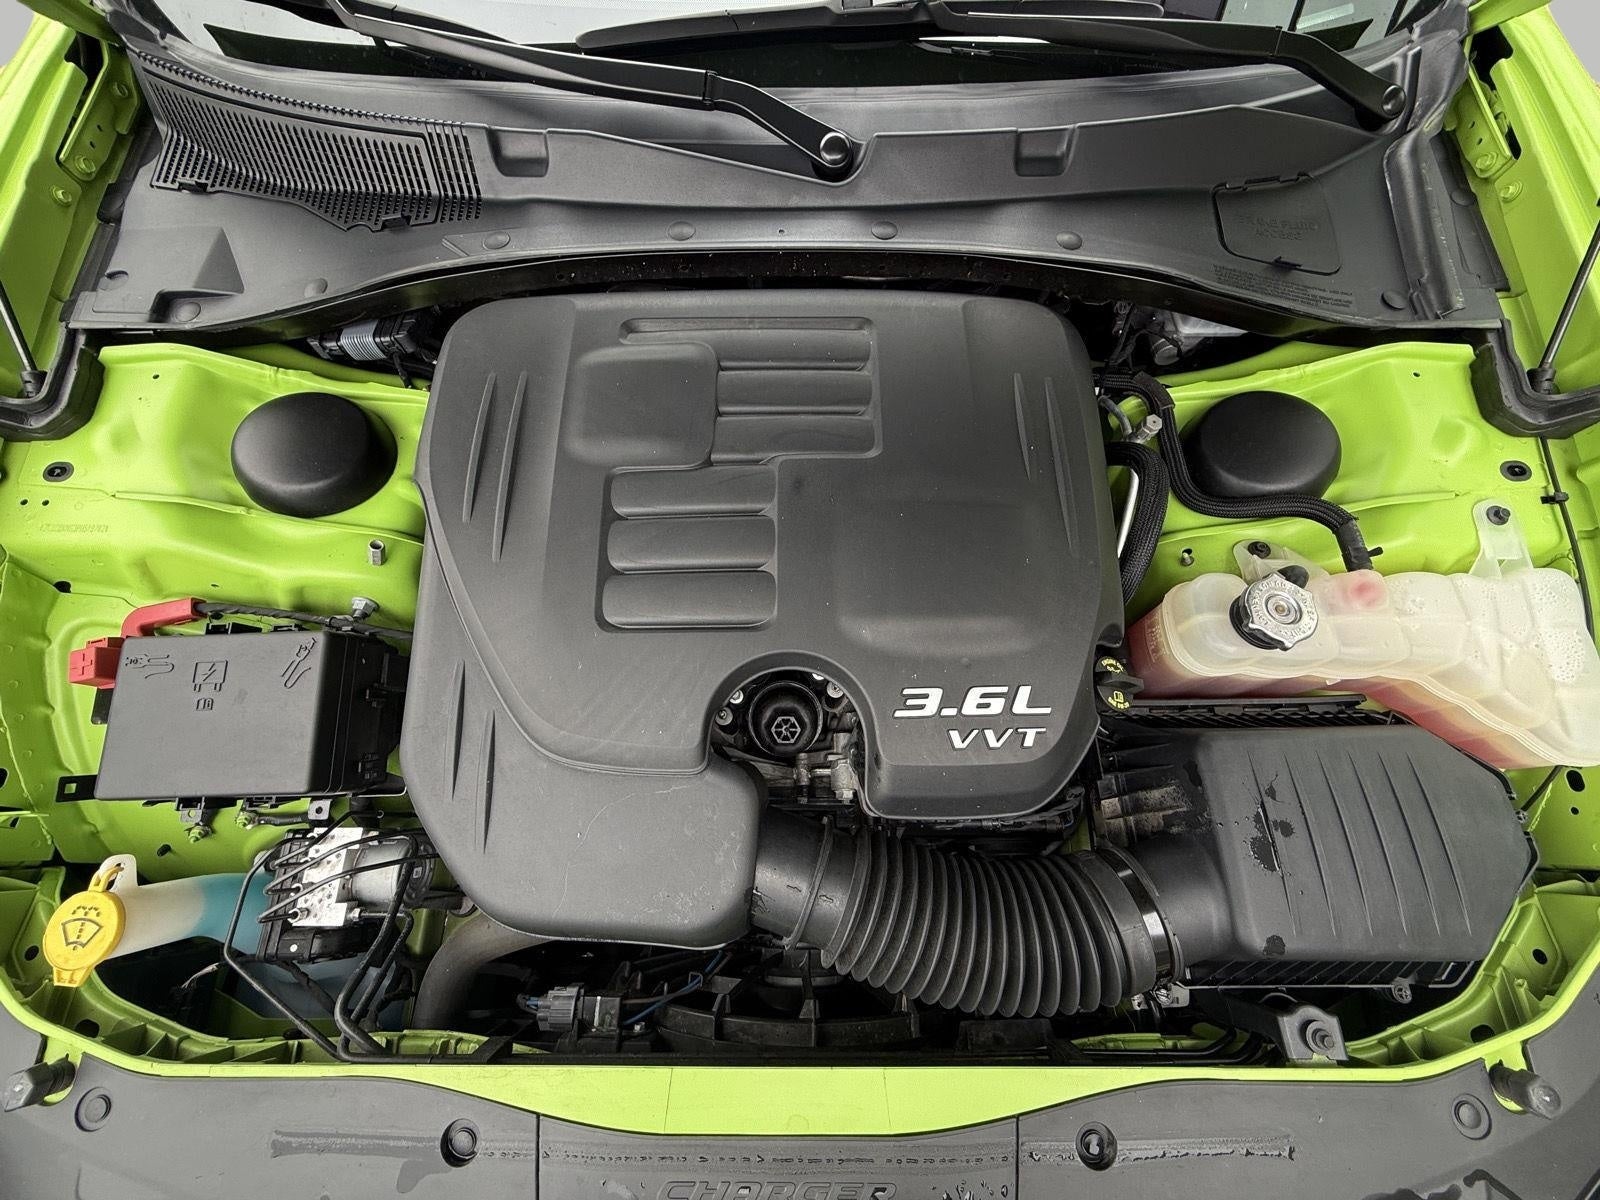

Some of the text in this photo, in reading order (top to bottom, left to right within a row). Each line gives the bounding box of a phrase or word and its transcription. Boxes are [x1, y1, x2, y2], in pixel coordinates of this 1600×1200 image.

[894, 686, 1052, 718] 3.6L
[948, 728, 1047, 749] VVT
[657, 1180, 898, 1200] CHARGER
